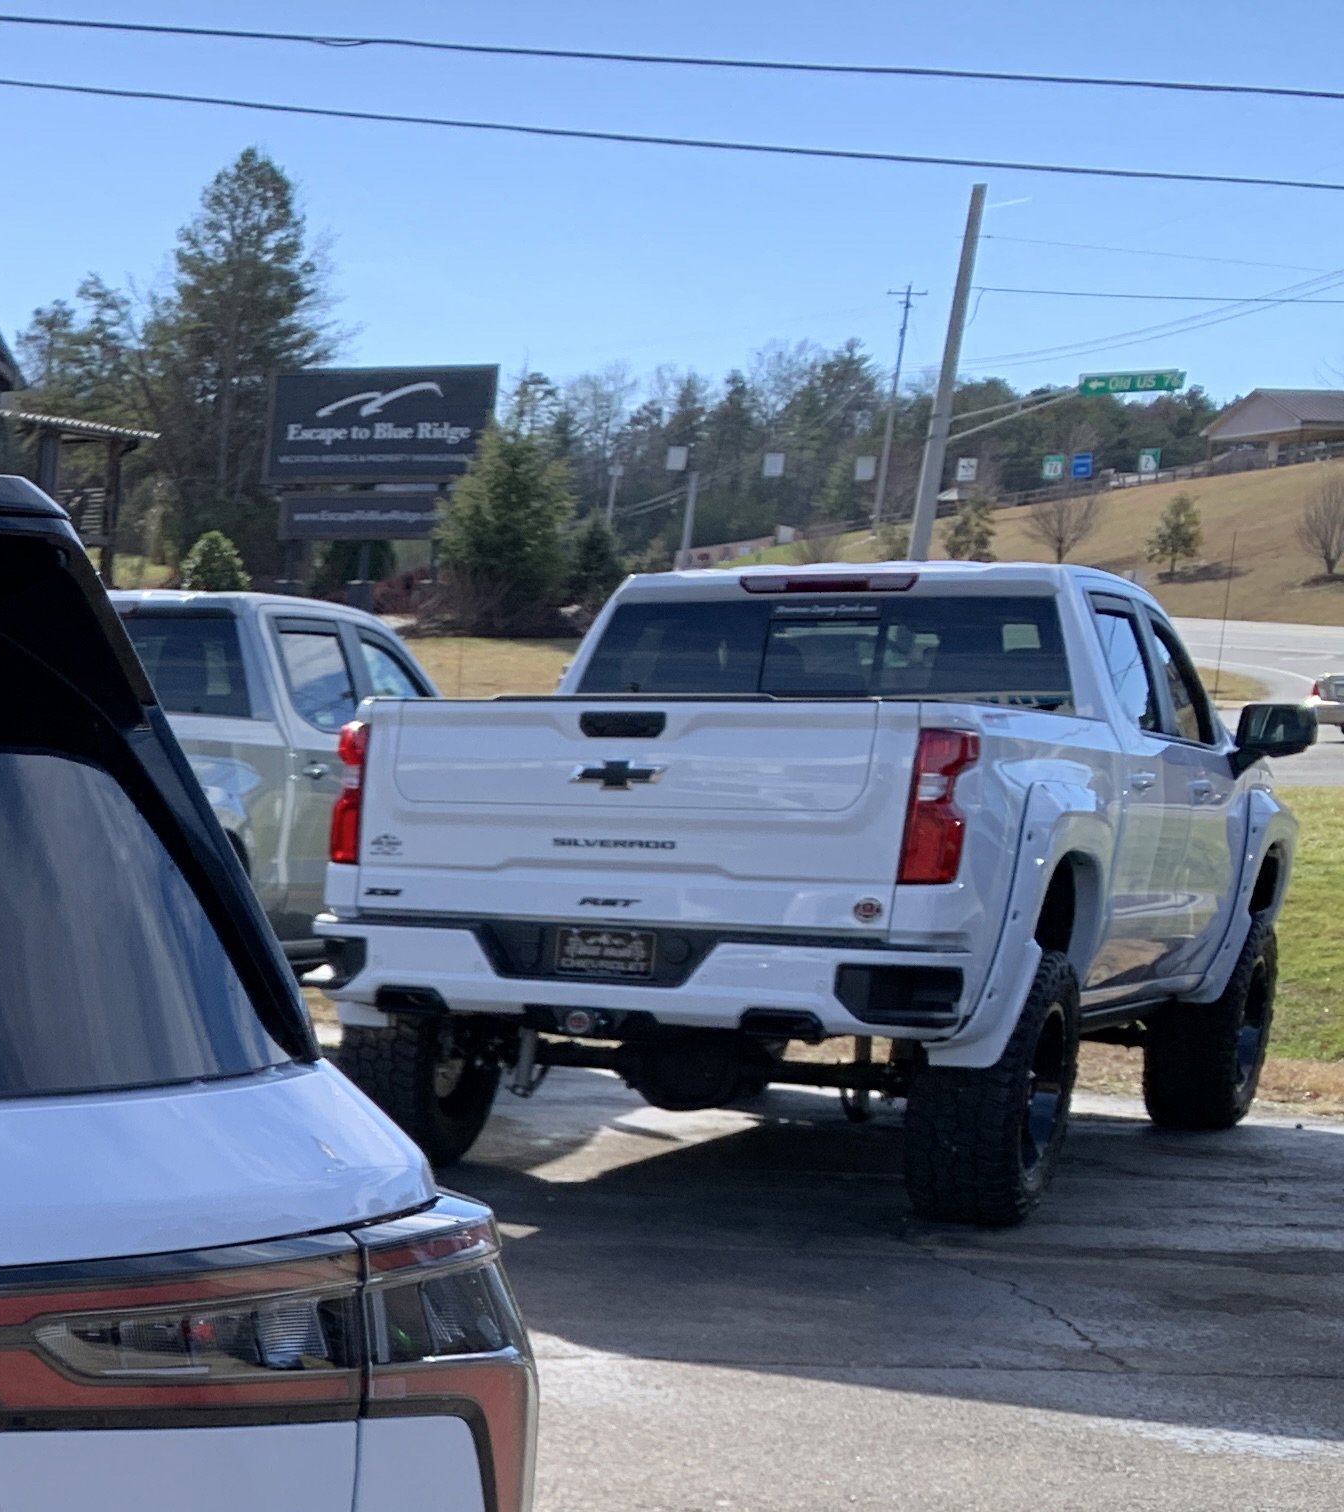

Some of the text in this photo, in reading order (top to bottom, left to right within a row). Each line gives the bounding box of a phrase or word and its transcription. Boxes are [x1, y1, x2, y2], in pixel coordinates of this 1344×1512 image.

[1109, 373, 1181, 390] Old US 76
[286, 422, 471, 445] Escape to Blue Ridge
[552, 837, 677, 850] SILVERADO
